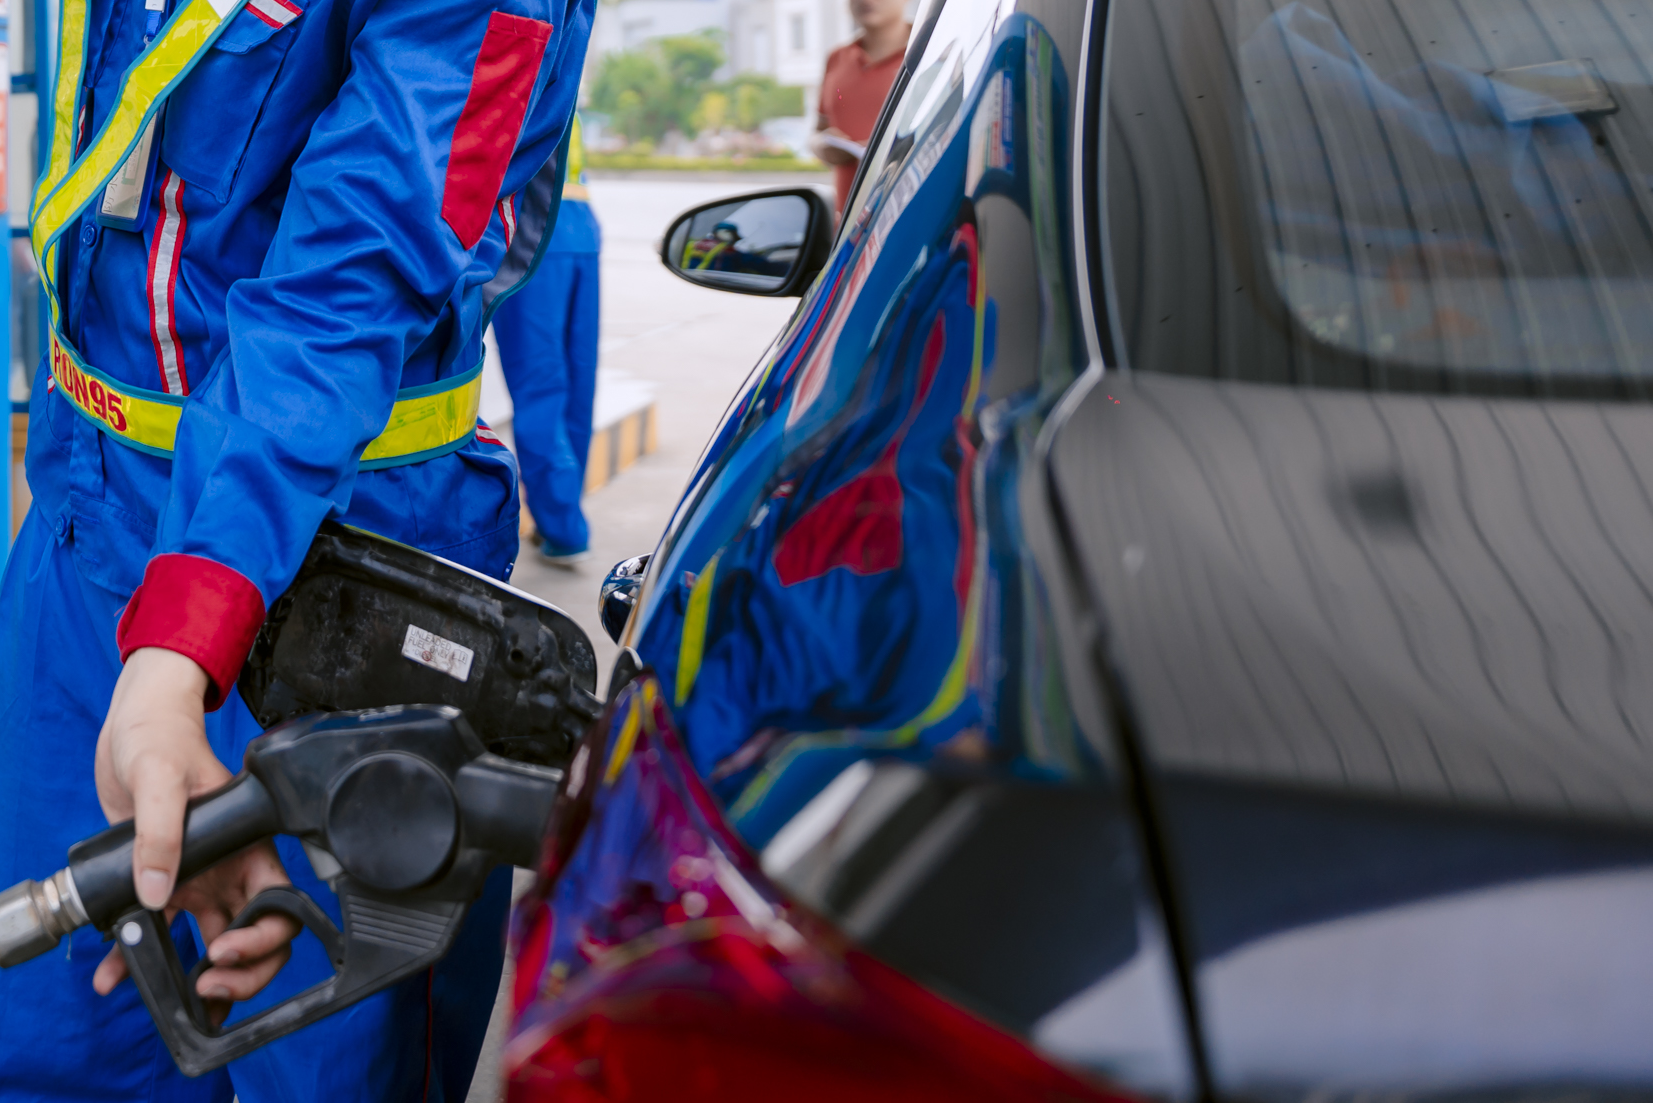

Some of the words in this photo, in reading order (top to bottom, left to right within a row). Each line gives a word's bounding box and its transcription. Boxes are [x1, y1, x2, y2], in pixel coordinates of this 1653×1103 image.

[54, 336, 127, 432] RON95
[407, 636, 426, 651] FUEL
[410, 626, 452, 651] UNLEADED
